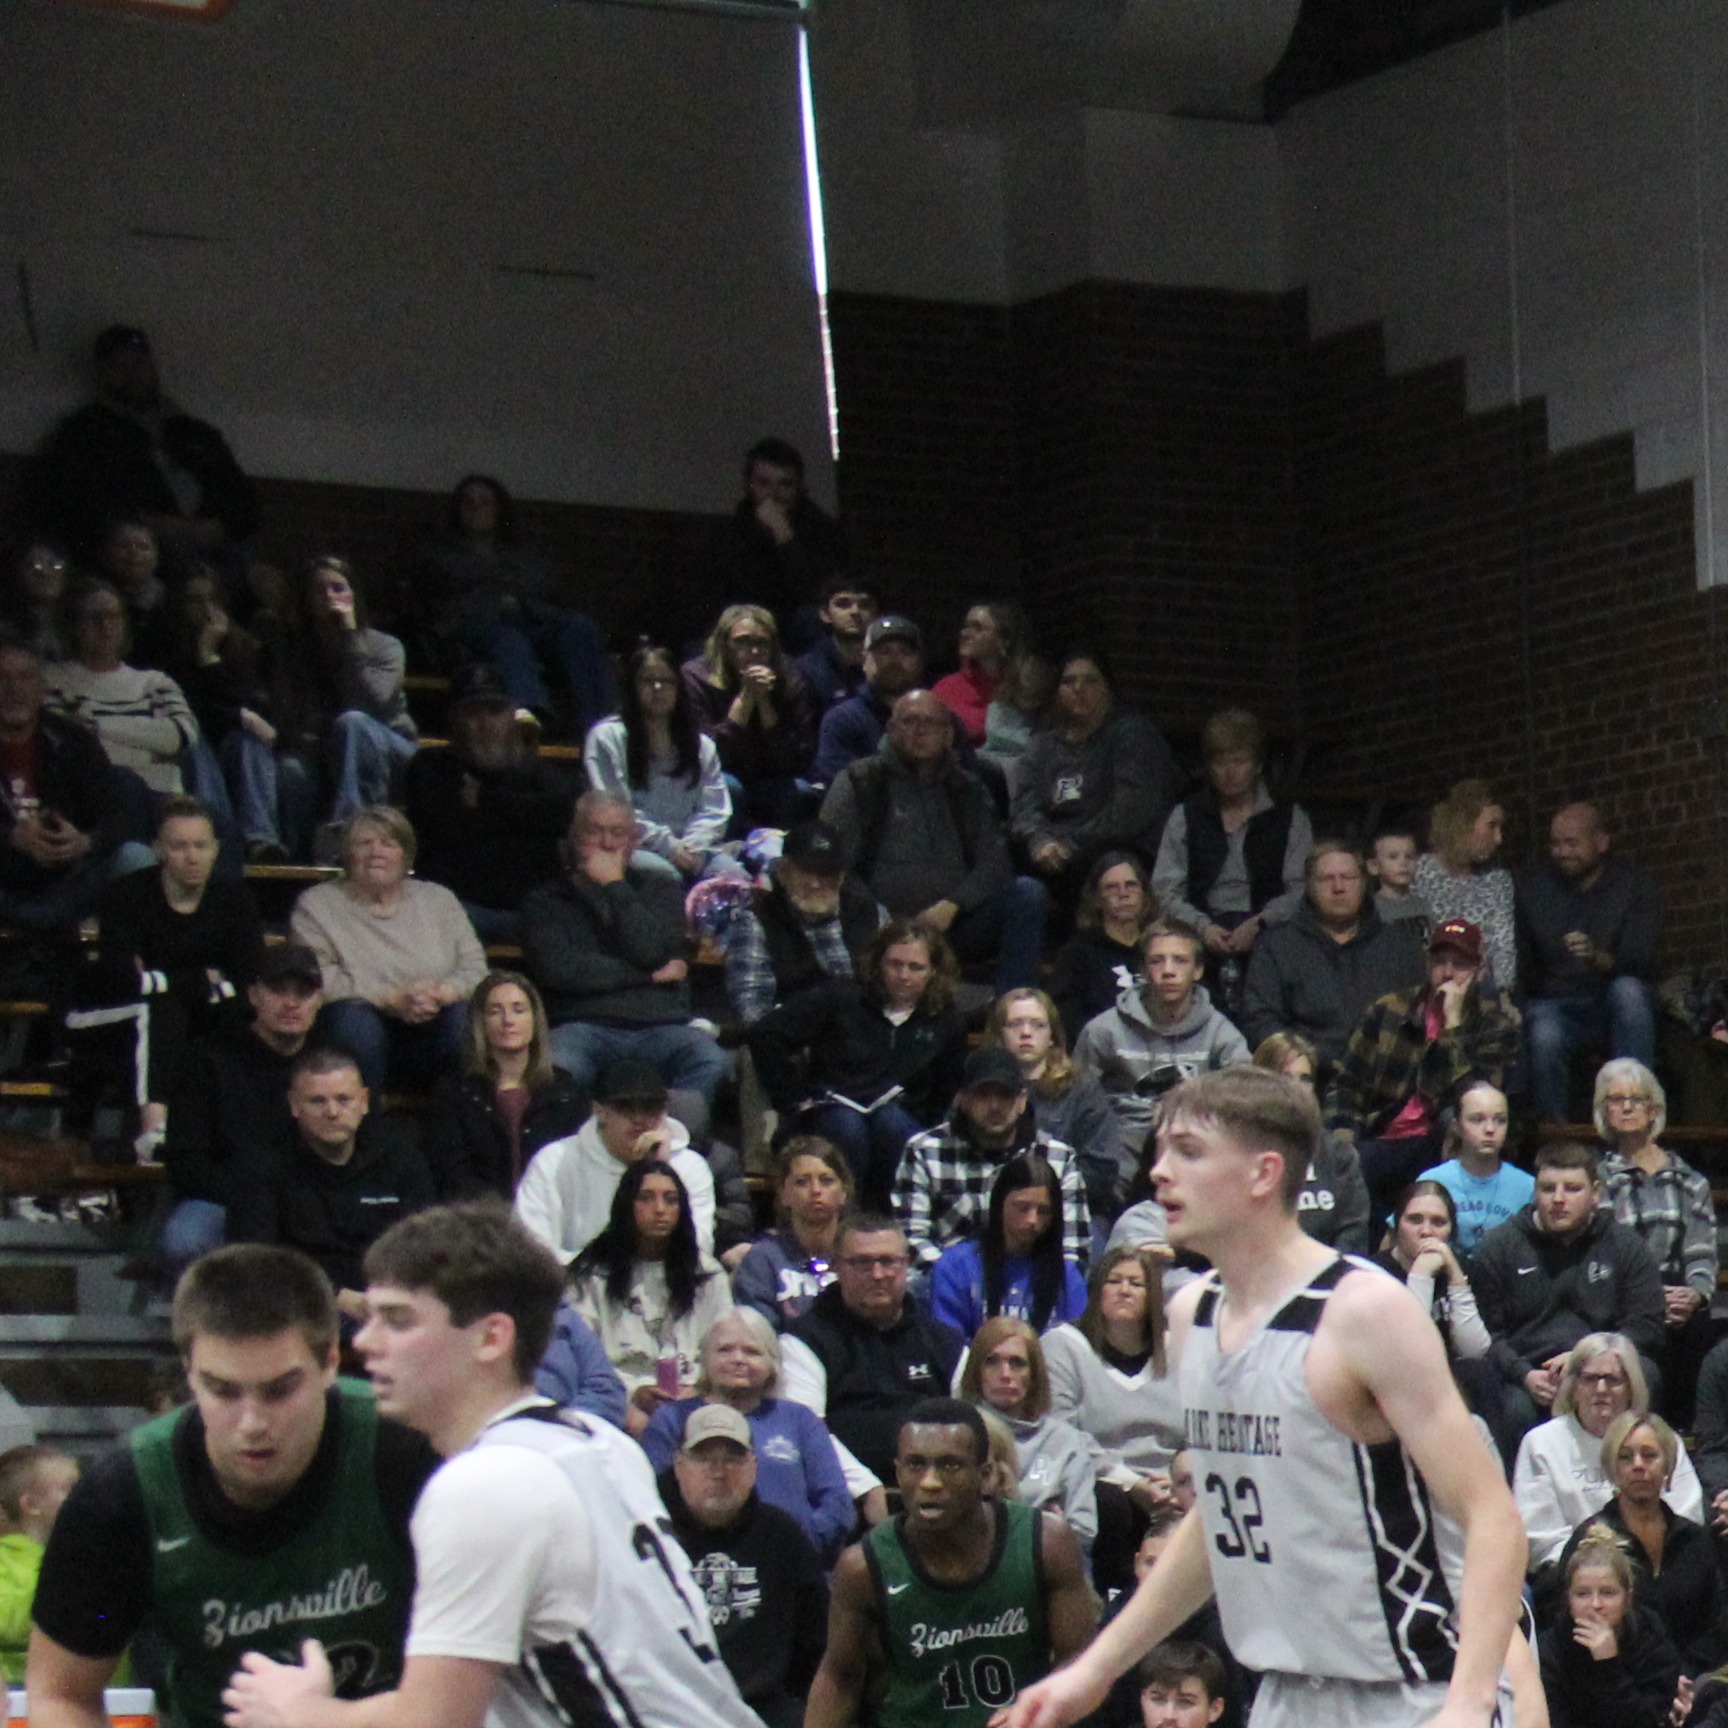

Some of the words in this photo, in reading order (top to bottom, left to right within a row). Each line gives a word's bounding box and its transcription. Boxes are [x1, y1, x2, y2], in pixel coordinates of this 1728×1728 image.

[1205, 1472, 1273, 1564] 32
[202, 1562, 389, 1646] Zionsville
[909, 1607, 1030, 1658] Zionsville
[938, 1655, 1016, 1710] 10
